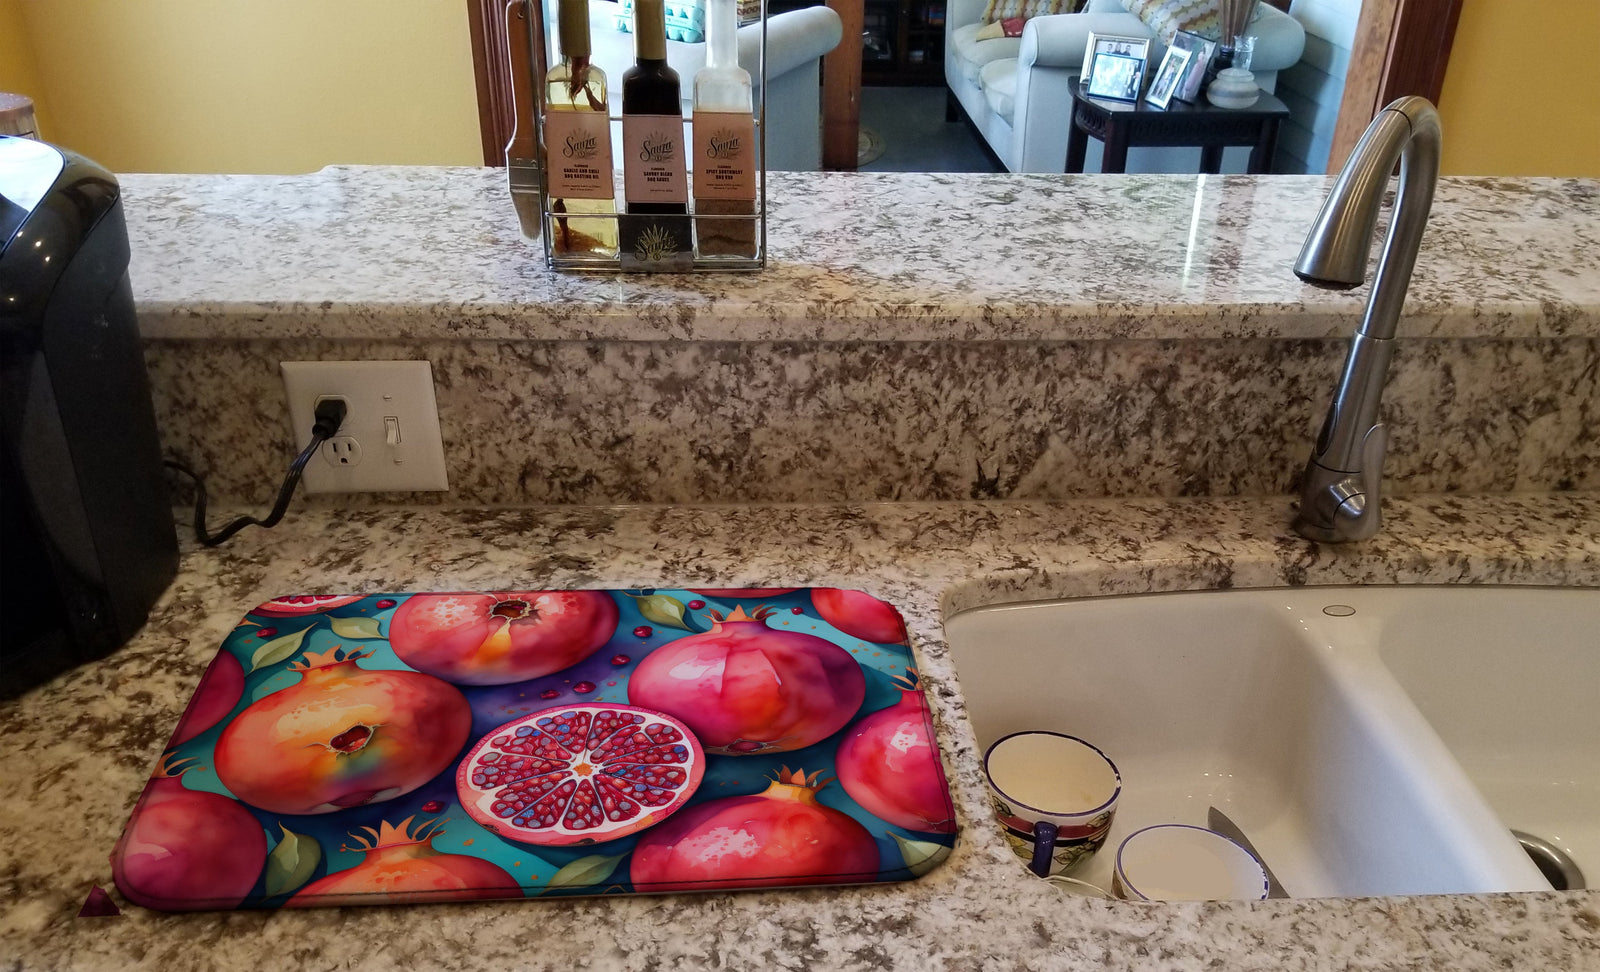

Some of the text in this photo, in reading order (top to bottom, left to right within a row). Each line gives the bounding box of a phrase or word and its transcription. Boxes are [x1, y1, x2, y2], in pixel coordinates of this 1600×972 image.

[563, 136, 598, 158] Sauza
[640, 140, 674, 162] Sauza
[706, 137, 741, 159] Sauza
